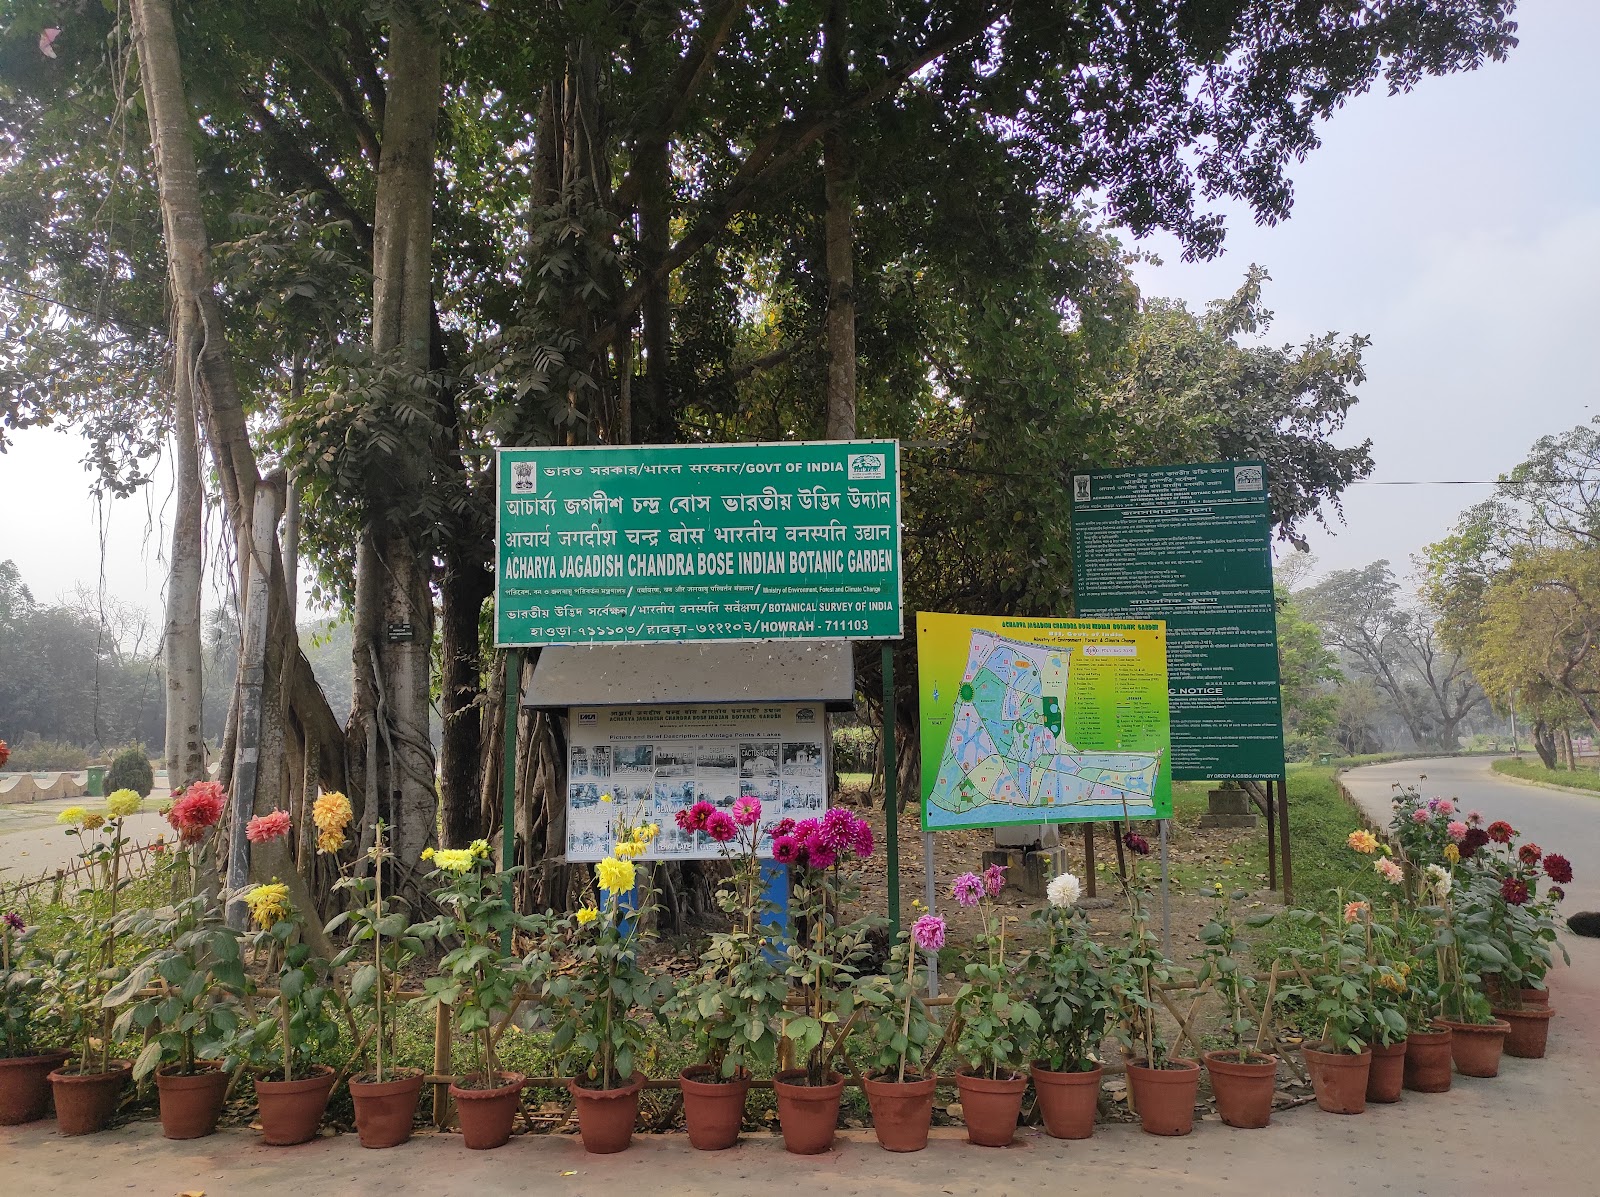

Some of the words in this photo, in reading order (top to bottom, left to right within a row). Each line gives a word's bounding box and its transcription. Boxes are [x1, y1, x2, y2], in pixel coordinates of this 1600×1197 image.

[543, 466, 584, 476] ভারত
[785, 462, 802, 473] OF
[807, 462, 844, 472] INDIA
[563, 490, 624, 515] জগদীশ
[631, 497, 662, 514] চন্দ্র
[669, 494, 711, 514] বোস
[720, 486, 793, 512] ভারতীয়
[797, 485, 841, 510] উদ্ভিদ
[847, 486, 891, 509] উদ্যান
[505, 524, 551, 548] आचार्य
[557, 523, 618, 548] जगदीश
[624, 529, 661, 547] चन्द्र
[668, 521, 705, 545] बोस
[714, 520, 778, 544] भारतीय
[784, 519, 847, 542] वनस्पति
[853, 525, 891, 541] उद्यान
[505, 556, 556, 580] ACHARYA
[560, 555, 624, 578] JAGADISH
[627, 553, 694, 577] CHANDRA
[698, 551, 734, 575] BOSE
[738, 551, 785, 574] INDIAN
[790, 550, 843, 574] BOTANIC
[847, 549, 892, 573] GARDEN
[863, 585, 881, 593] Change
[505, 606, 550, 619] ভারতীয়
[554, 604, 583, 617] উদ্ভিদ
[679, 601, 719, 613] वनस्पति
[819, 602, 853, 612] SURVEY
[855, 602, 866, 611] OF
[869, 602, 893, 611] INDIA
[825, 620, 868, 631] 711103
[742, 749, 761, 757] CACTUS
